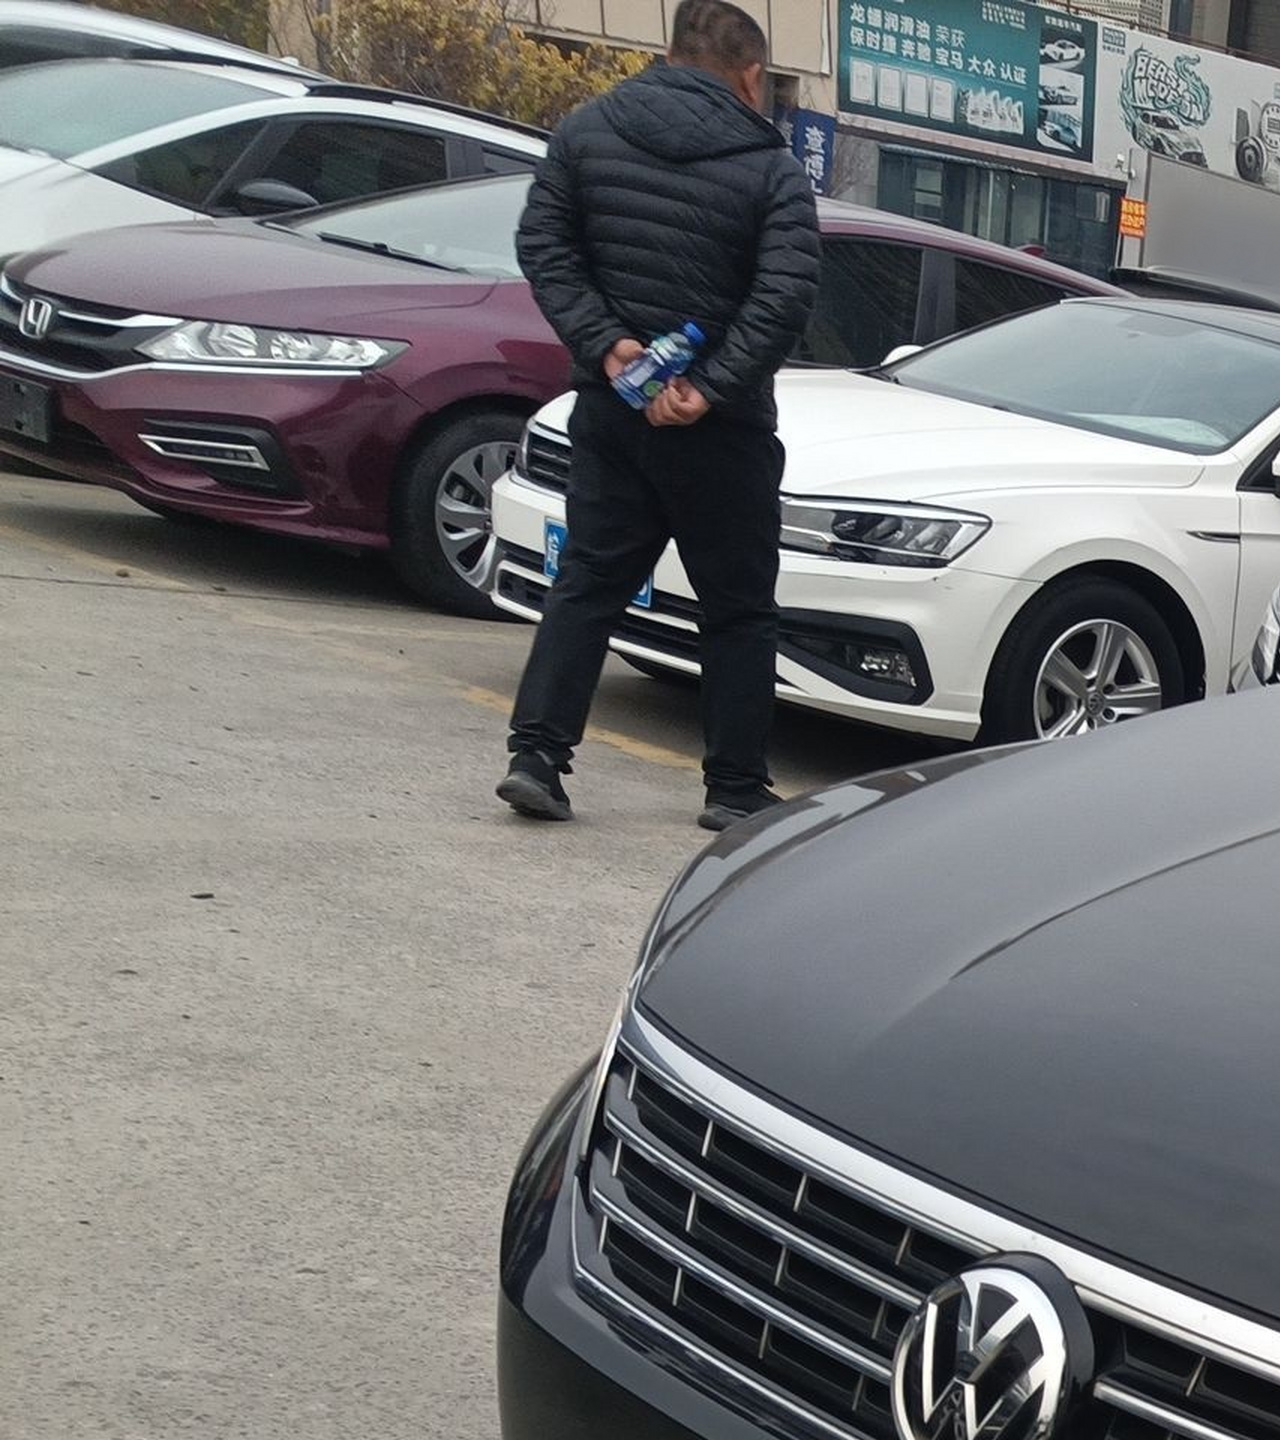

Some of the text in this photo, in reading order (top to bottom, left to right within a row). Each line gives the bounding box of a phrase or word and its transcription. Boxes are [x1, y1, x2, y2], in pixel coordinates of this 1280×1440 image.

[850, 25, 1027, 85] 保时捷 奔驰 宝马 大众 认证
[935, 24, 966, 49] 荣获
